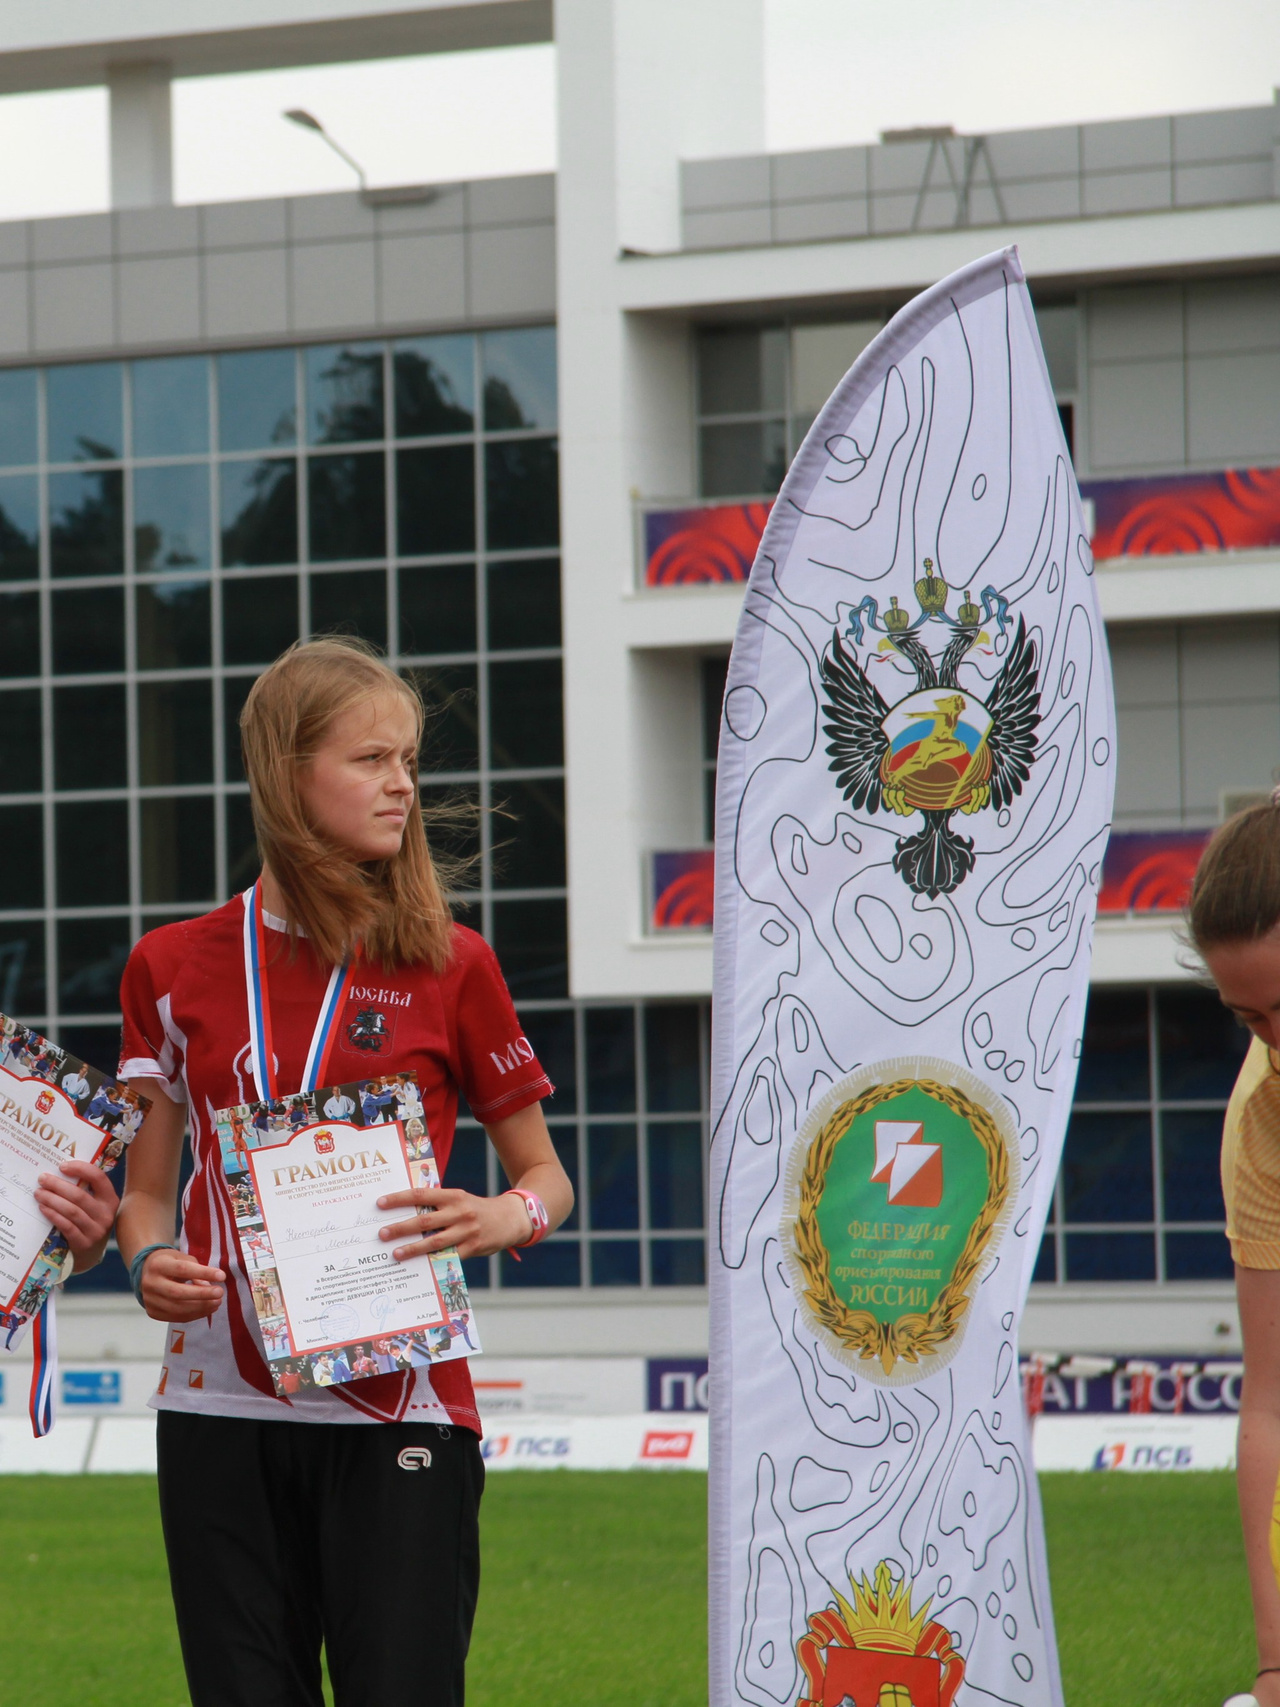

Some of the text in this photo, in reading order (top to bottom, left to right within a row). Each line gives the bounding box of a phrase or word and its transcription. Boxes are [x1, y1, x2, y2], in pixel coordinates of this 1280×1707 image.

[0, 1139, 39, 1167] НАГРАЖДАЕТСЯ
[272, 1149, 388, 1187] ГРАМОТА
[275, 1184, 318, 1196] МИНИСТЕРСТВО
[328, 1174, 364, 1185] ФИЗИЧЕСКОЙ
[365, 1169, 391, 1178] КУЛЬТУРЕ
[293, 1191, 314, 1199] СПОРТУ
[315, 1182, 355, 1194] ЧЕЛЯБИНСКОЙ
[356, 1177, 381, 1186] ОБЛАСТИ
[312, 1193, 362, 1207] НАГРАЖДАЕТСЯ
[324, 1252, 388, 1272] ЗА 2 МЕСТО
[321, 1270, 361, 1283] Всероссийских
[323, 1279, 358, 1291] спортивному
[360, 1268, 407, 1283] ориентированию
[393, 1273, 419, 1282] человека
[326, 1297, 346, 1306] группе:
[347, 1290, 374, 1301] ДЕВУШКИ
[375, 1287, 386, 1295] (ДО
